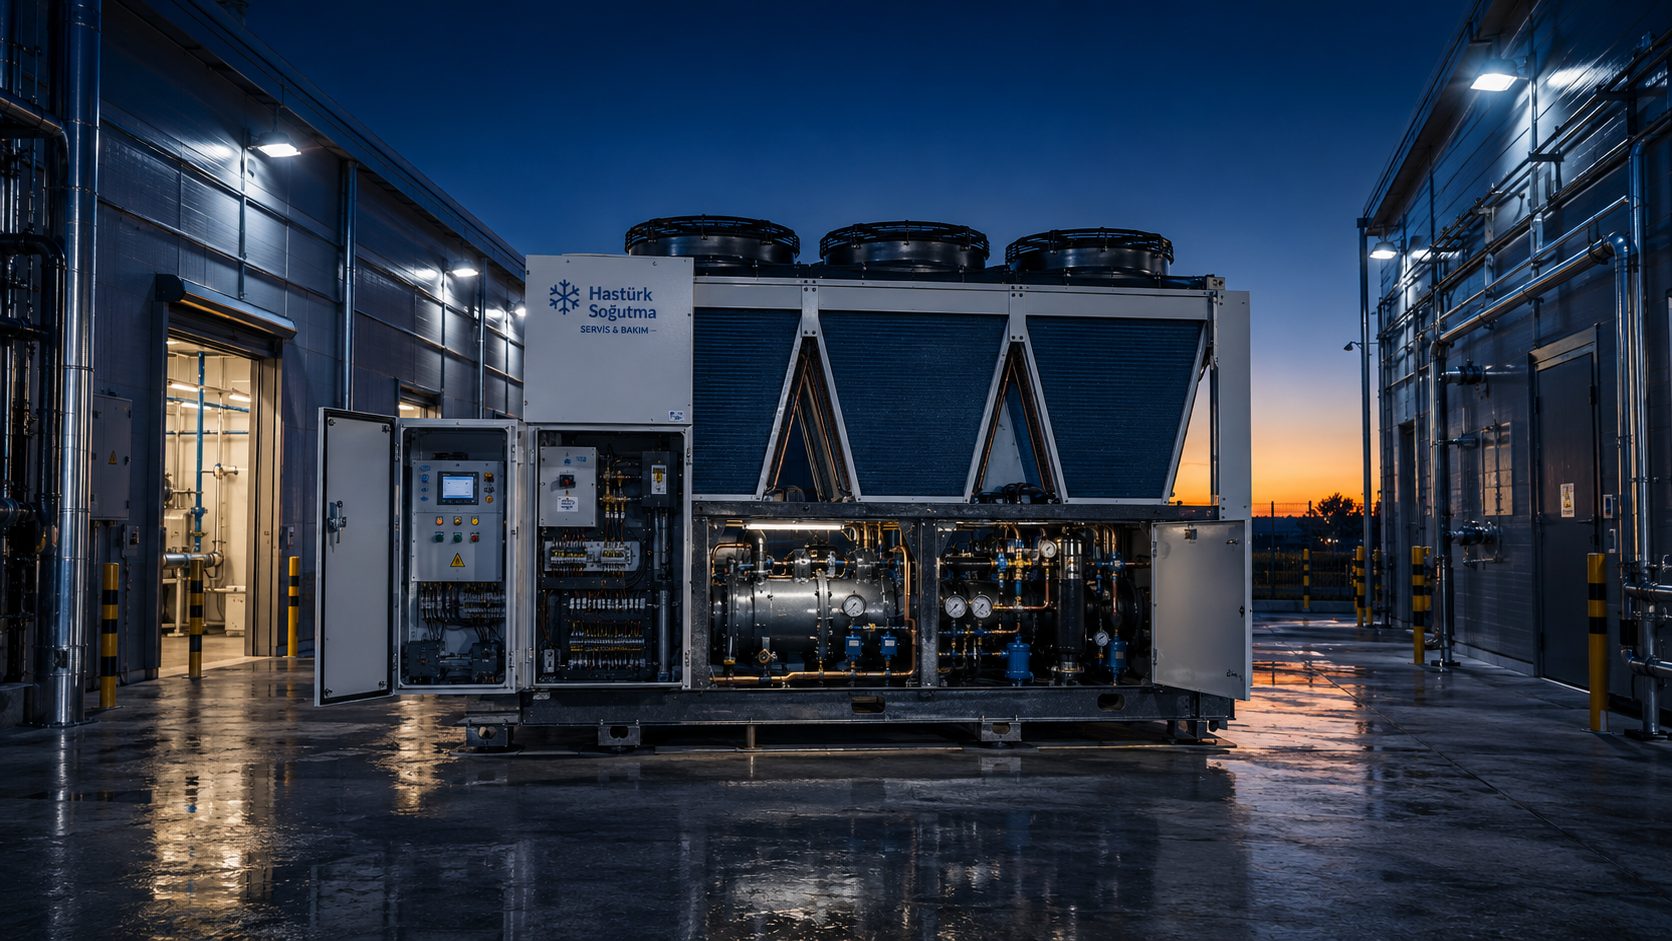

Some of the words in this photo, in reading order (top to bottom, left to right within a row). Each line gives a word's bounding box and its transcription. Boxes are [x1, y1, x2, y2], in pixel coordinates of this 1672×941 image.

[589, 286, 652, 301] Hastürk
[589, 304, 656, 321] Soğutma
[612, 326, 619, 334] &
[621, 326, 649, 334] BAKIM
